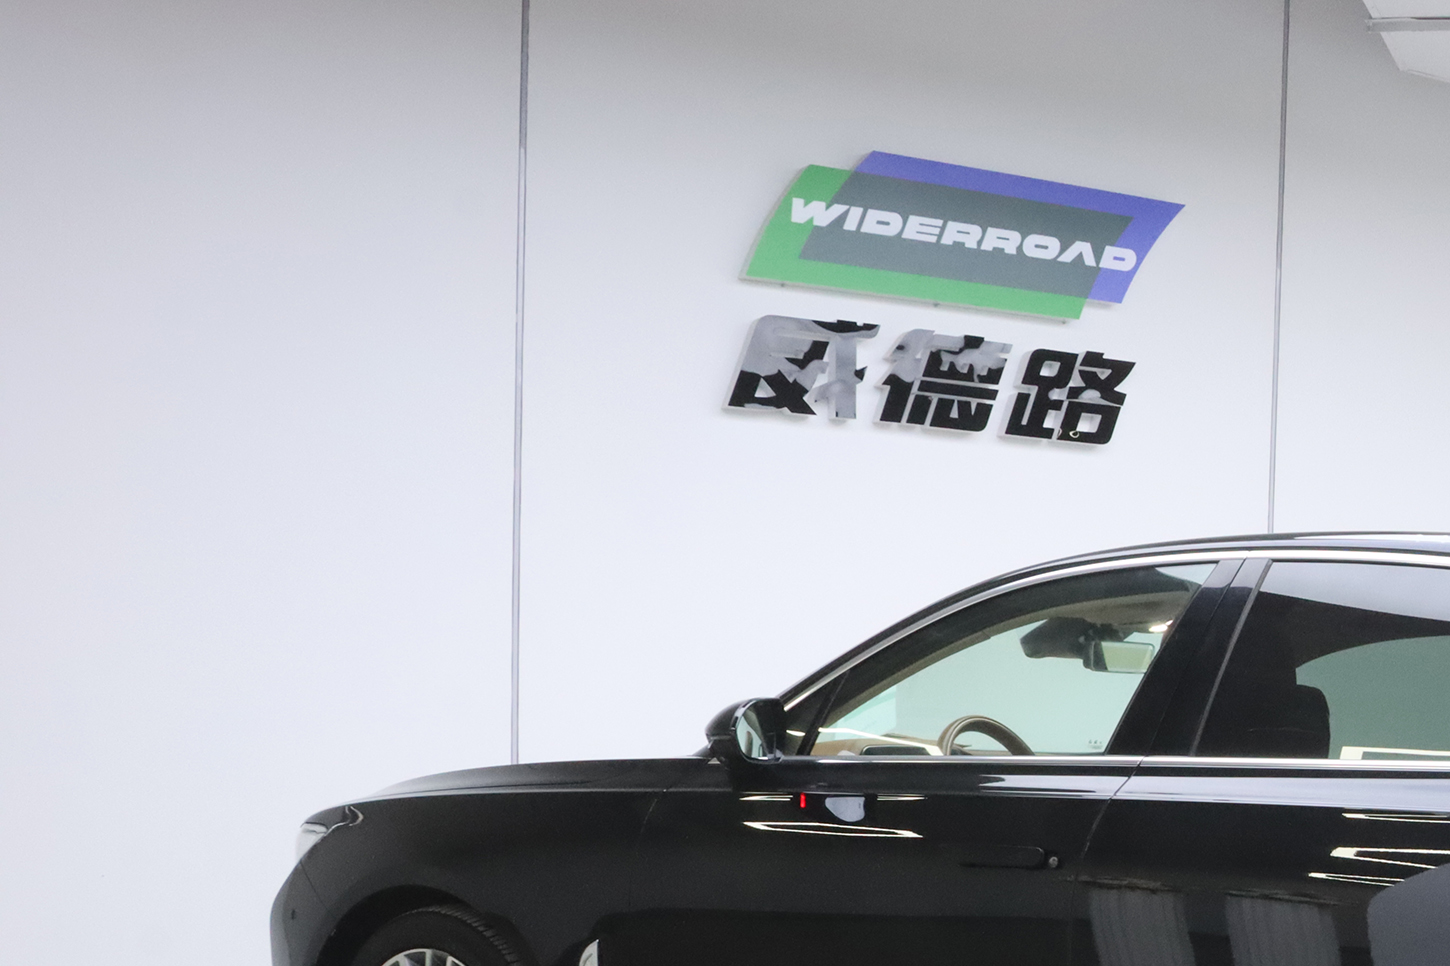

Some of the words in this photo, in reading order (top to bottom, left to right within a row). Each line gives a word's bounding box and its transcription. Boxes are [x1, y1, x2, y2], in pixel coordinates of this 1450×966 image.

[790, 197, 1137, 272] WIDERROAD
[726, 314, 1136, 445] 威德路
